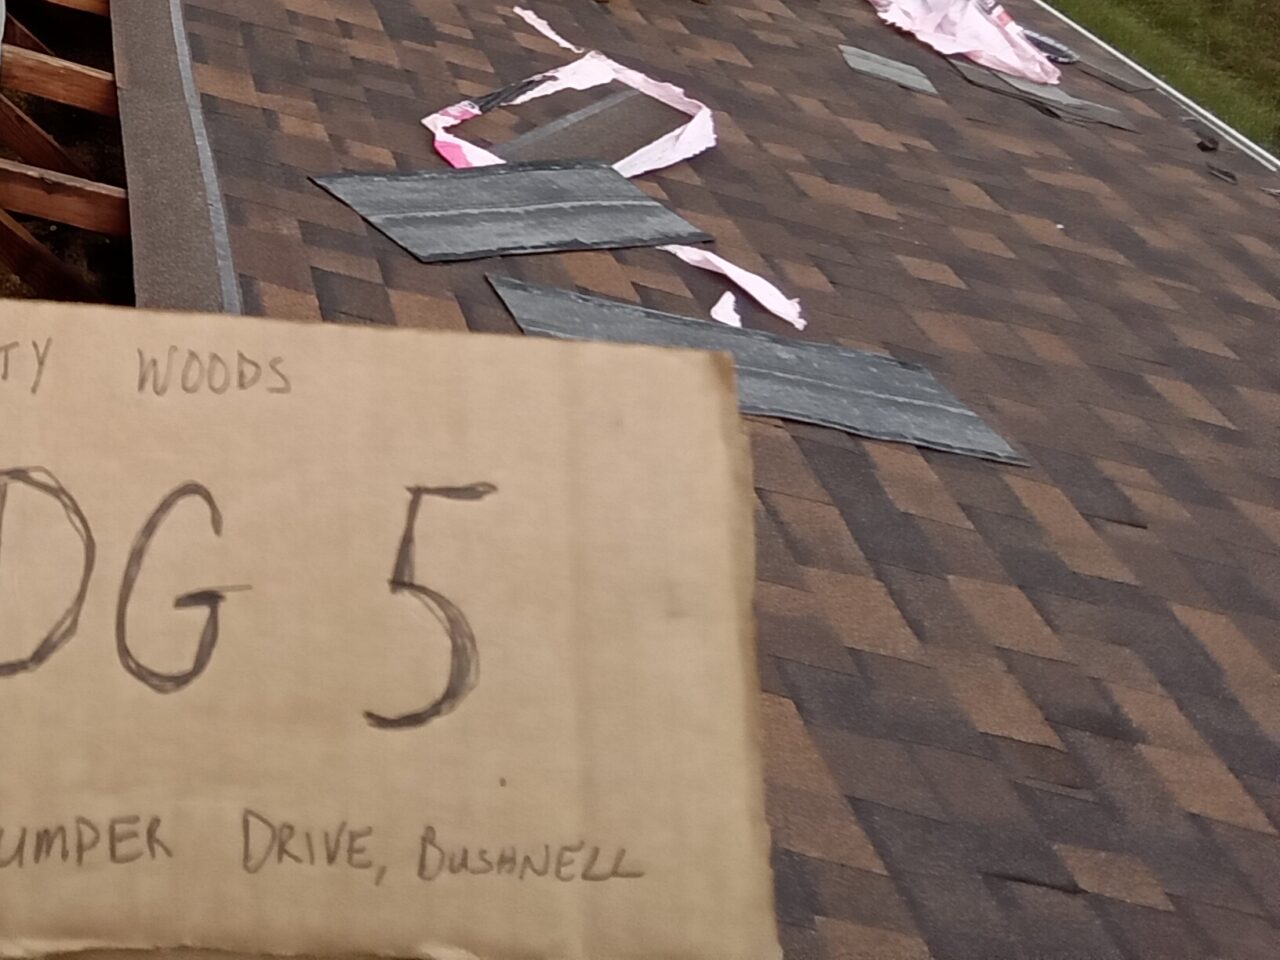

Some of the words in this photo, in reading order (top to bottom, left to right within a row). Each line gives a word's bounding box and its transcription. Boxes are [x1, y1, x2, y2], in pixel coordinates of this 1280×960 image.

[137, 345, 293, 397] WOODS
[361, 480, 500, 731] 5
[240, 808, 388, 886] DRIVE,
[416, 825, 649, 882] BUSHNELL
